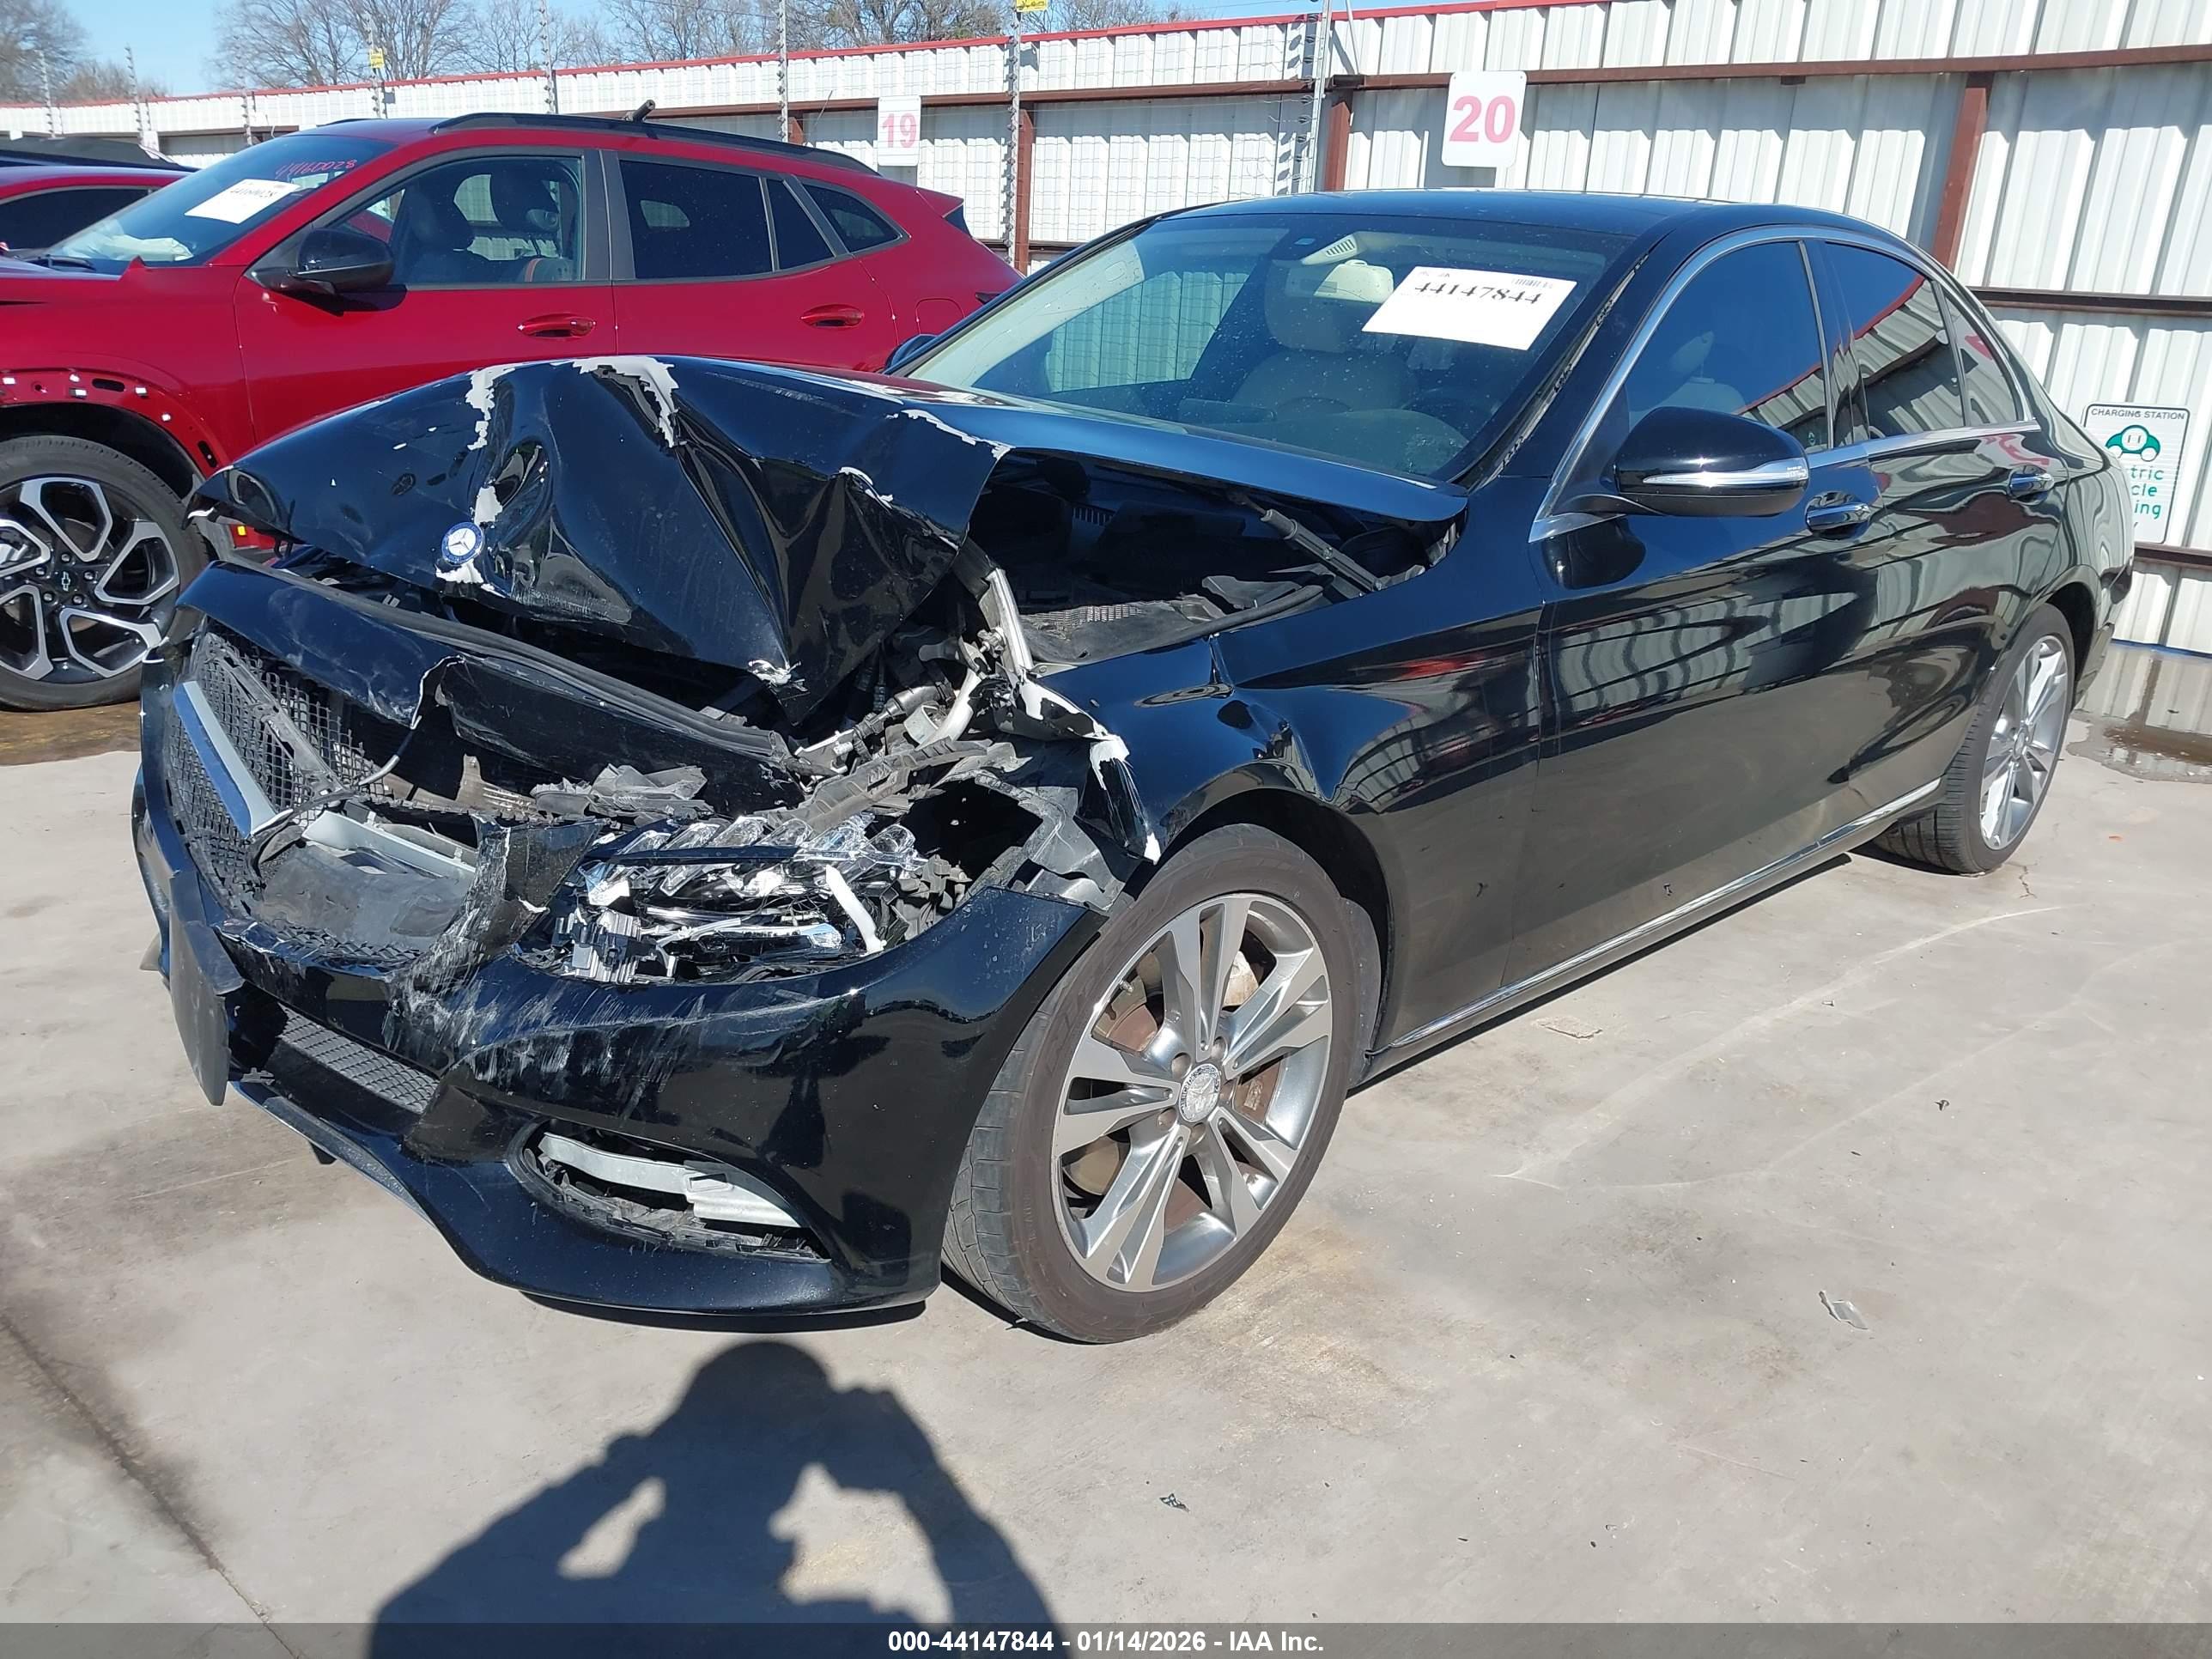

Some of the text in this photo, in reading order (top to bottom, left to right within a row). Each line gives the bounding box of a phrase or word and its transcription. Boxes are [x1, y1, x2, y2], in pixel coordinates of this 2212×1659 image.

[1449, 95, 1516, 143] 20
[882, 112, 917, 149] 19
[1414, 282, 1542, 304] 44147844
[2090, 408, 2185, 420] CHARGING STATION
[2130, 465, 2165, 481] tric
